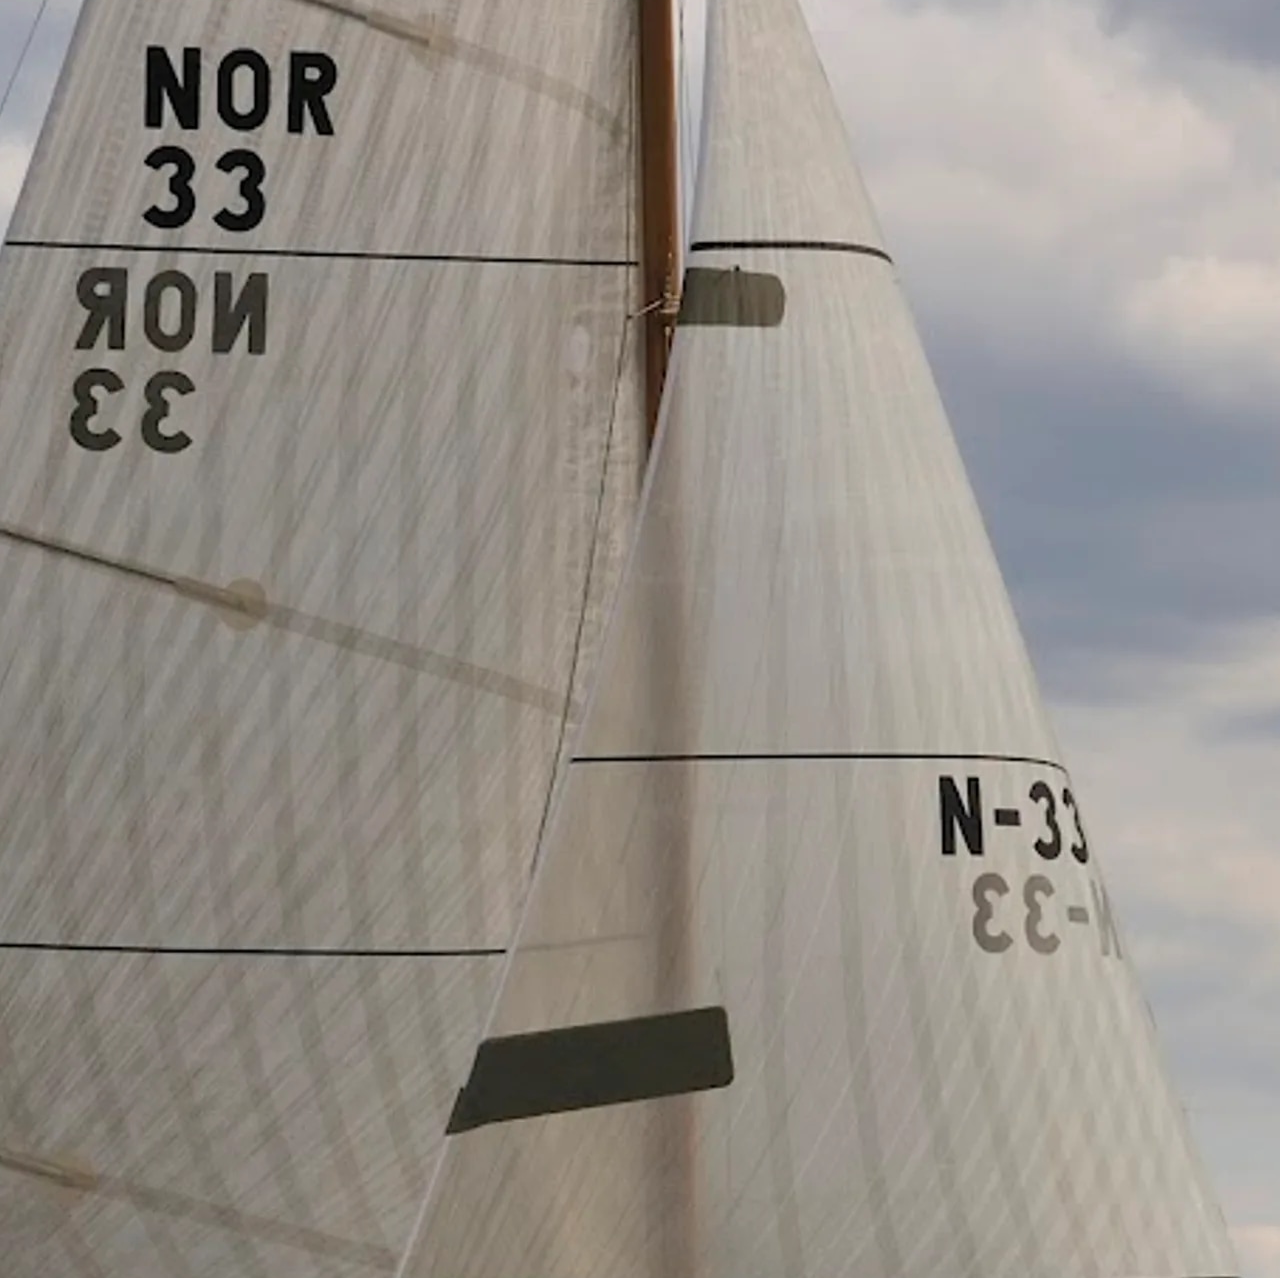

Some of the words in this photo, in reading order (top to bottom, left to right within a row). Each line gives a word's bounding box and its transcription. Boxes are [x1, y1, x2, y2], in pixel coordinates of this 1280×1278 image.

[144, 45, 337, 136] NOR
[142, 145, 266, 232] 33
[939, 775, 1089, 864] N-33
